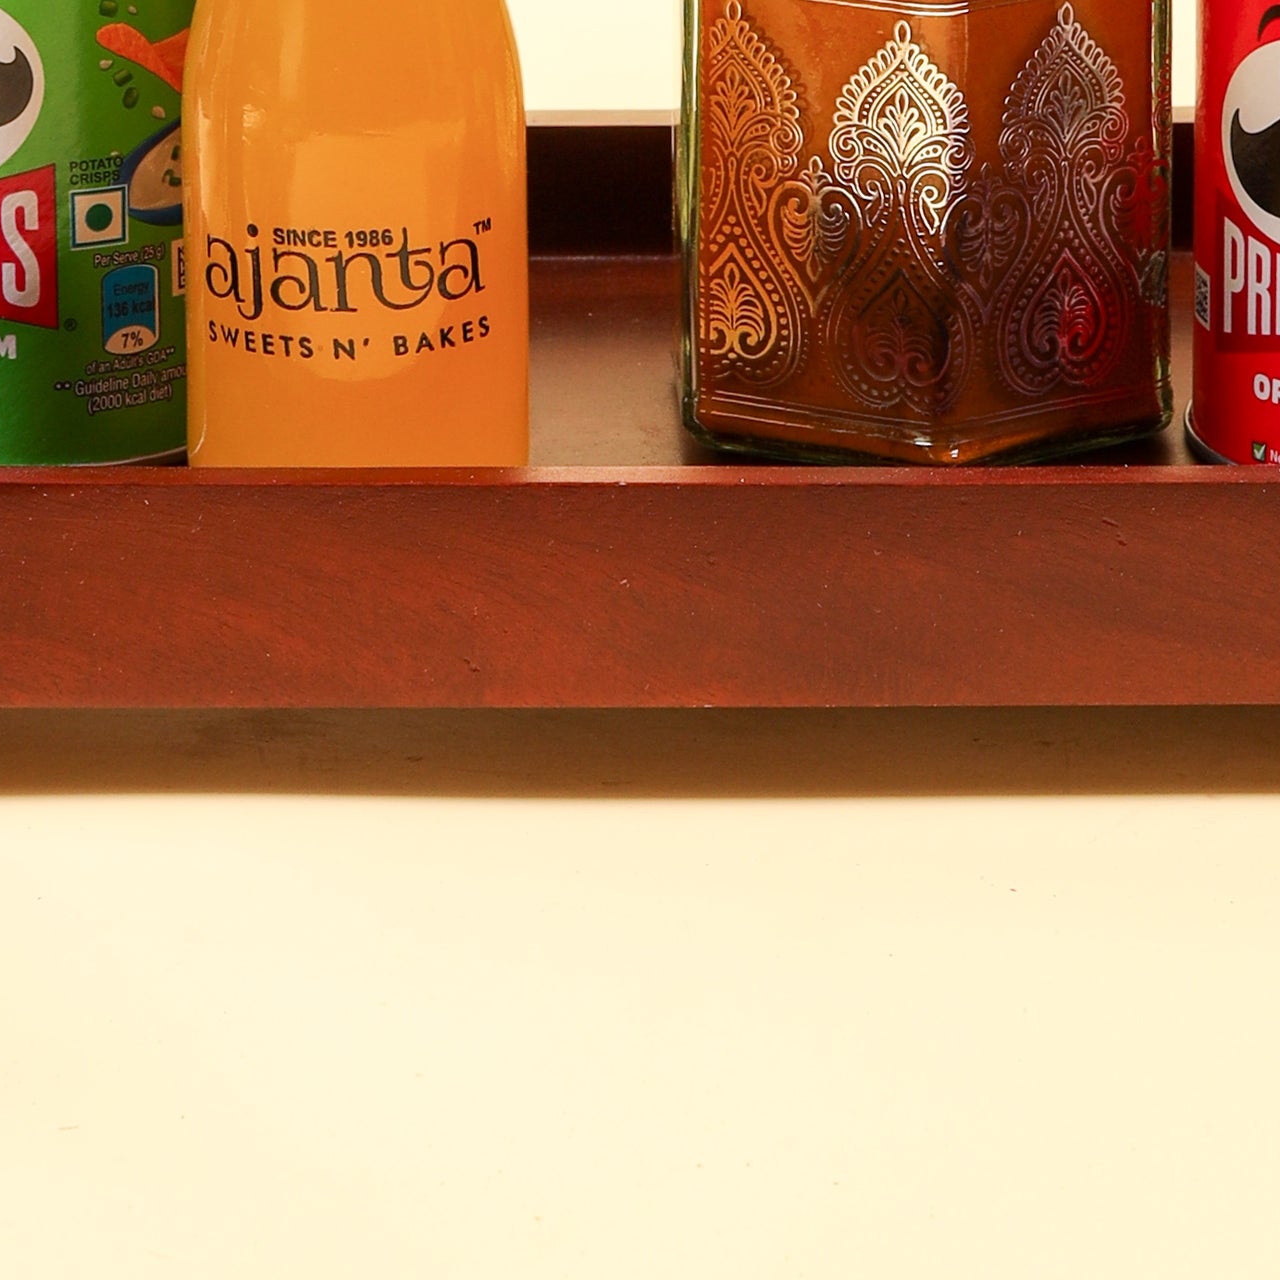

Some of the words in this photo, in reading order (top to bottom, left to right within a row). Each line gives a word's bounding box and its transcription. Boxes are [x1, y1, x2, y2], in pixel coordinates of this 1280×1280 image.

[69, 156, 124, 173] POTATO
[69, 170, 121, 186] CRISPS
[272, 227, 338, 249] SINCE
[344, 228, 394, 248] 1986
[94, 253, 110, 267] Per
[112, 249, 138, 265] Serve
[205, 223, 486, 321] ajanta
[112, 282, 150, 297] Energy
[131, 299, 156, 315] kcal
[121, 330, 144, 349] 7%
[208, 319, 314, 359] SWEETS
[332, 338, 370, 361] N'
[393, 315, 491, 358] BAKES
[75, 375, 130, 397] Guideline
[132, 371, 157, 389] Daily
[88, 392, 123, 416] (2000
[125, 388, 147, 405] kcal
[149, 383, 173, 402] diet)
